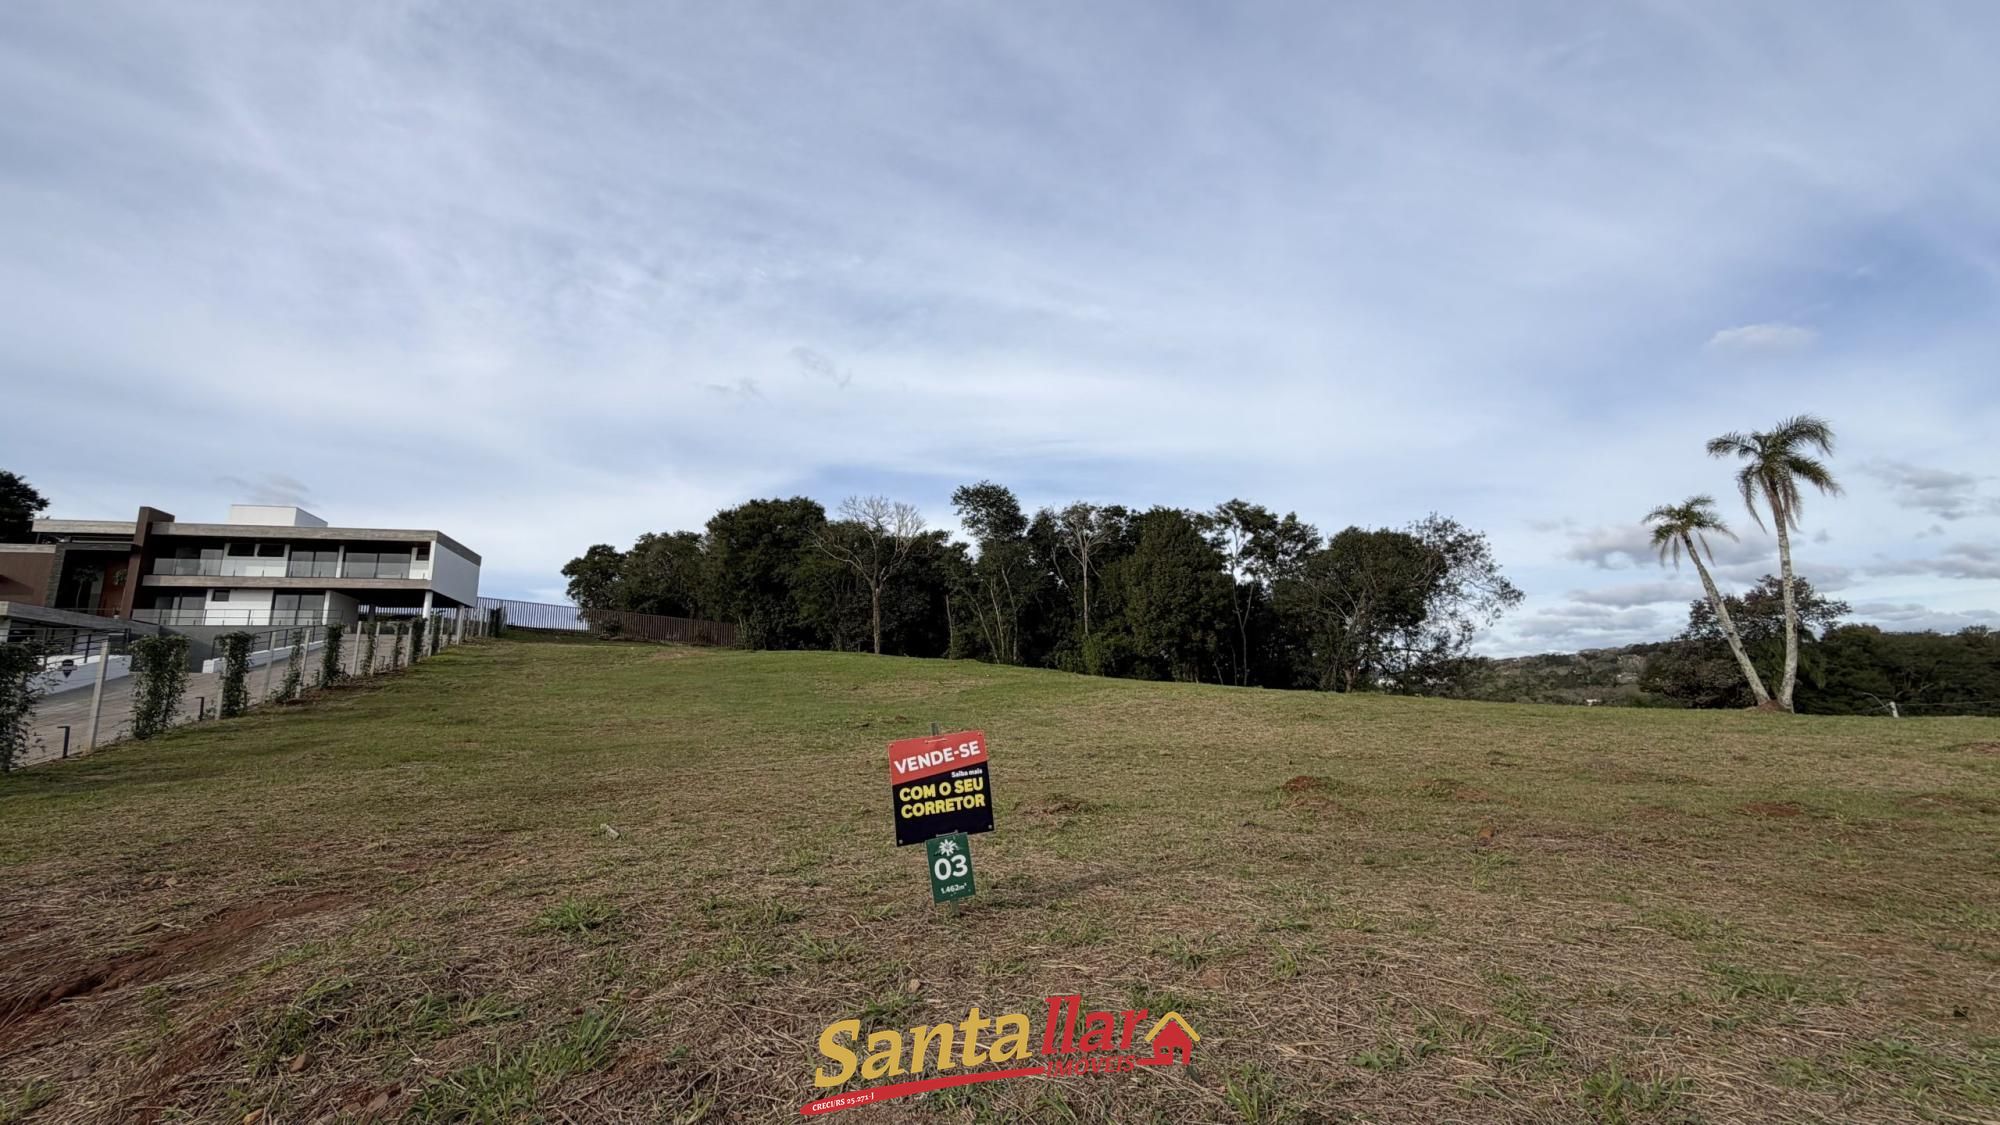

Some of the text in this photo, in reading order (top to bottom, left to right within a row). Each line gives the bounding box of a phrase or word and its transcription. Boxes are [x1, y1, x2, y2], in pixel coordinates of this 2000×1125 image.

[894, 741, 981, 774] VENDE-SE
[899, 777, 984, 802] COM O SEU
[901, 794, 986, 818] CORRETOR
[934, 854, 968, 880] 03
